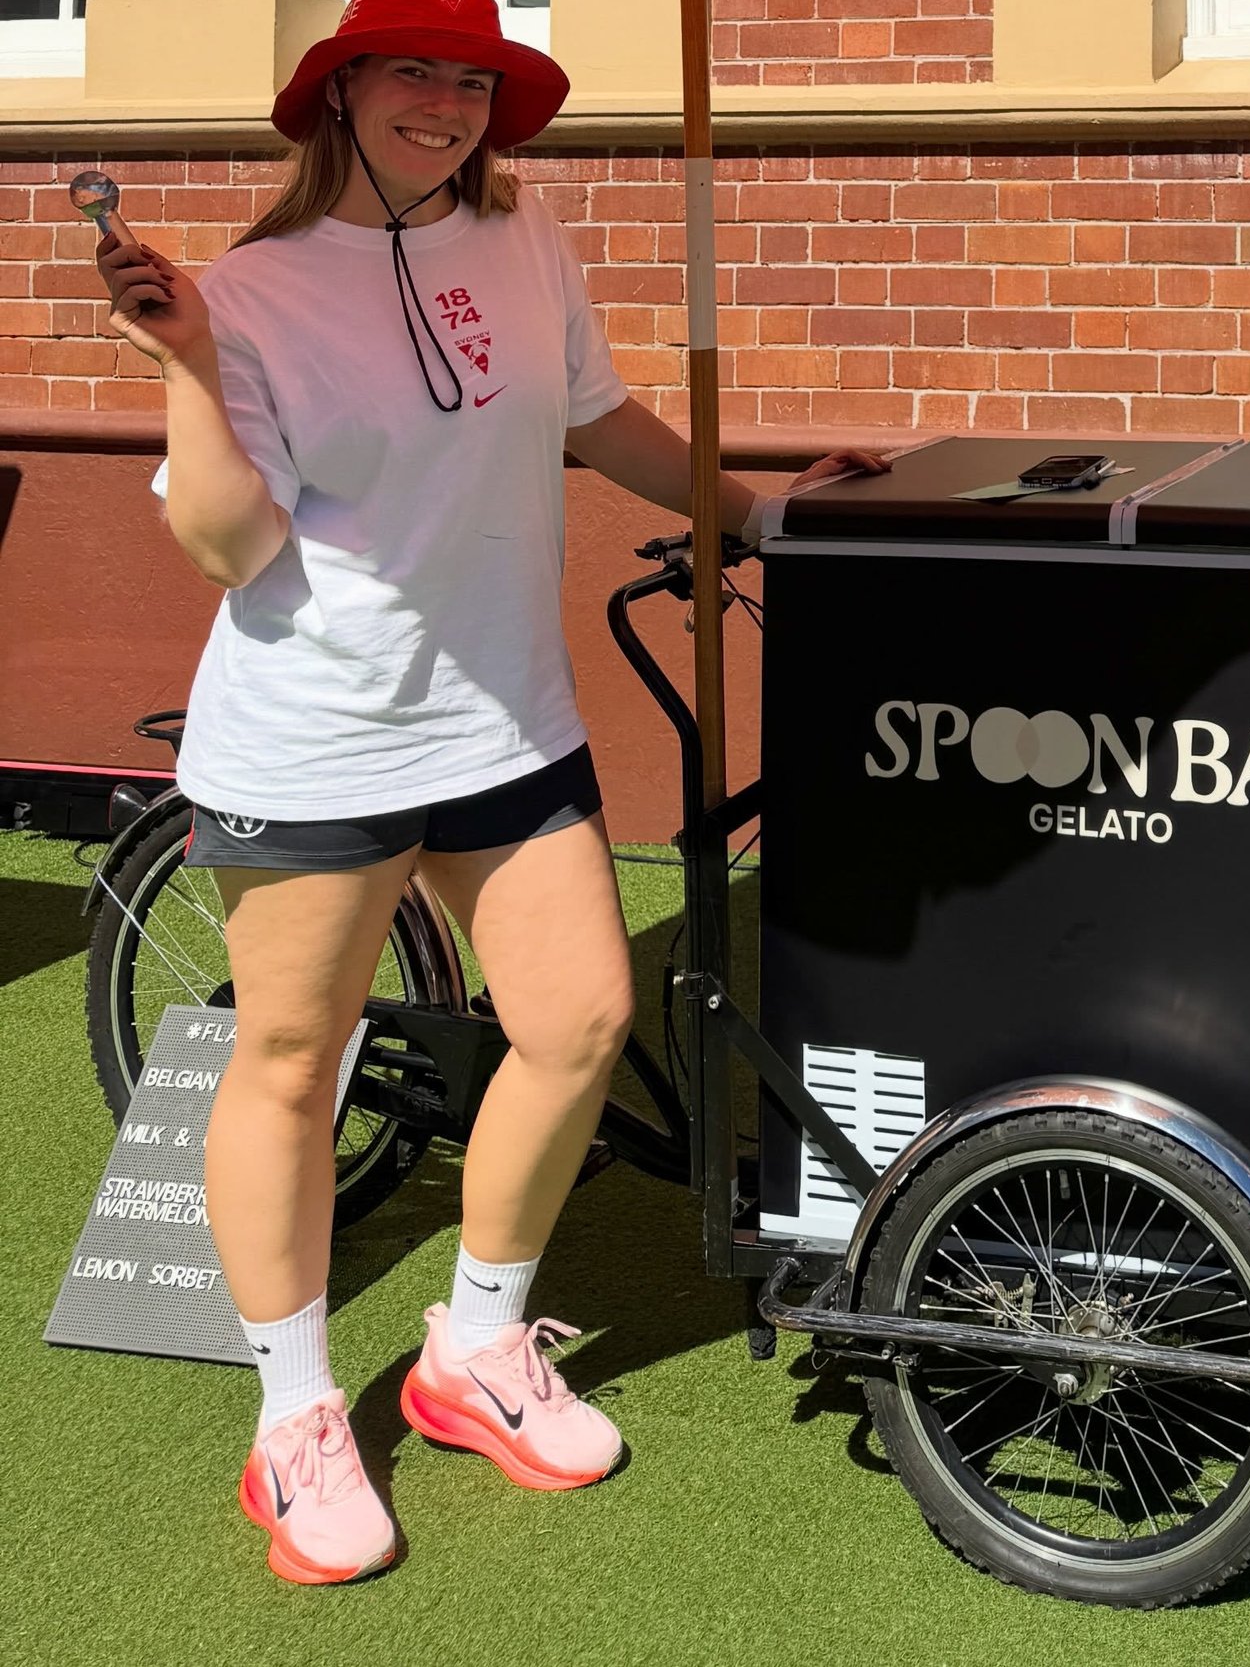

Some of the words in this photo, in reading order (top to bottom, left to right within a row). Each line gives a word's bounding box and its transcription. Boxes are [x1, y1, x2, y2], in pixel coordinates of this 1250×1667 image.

[435, 288, 471, 310] 18
[440, 306, 482, 330] 74
[454, 330, 490, 346] SYDNEY
[865, 700, 1155, 798] SPOON
[1029, 803, 1173, 843] GELATO
[143, 1067, 220, 1091] BELGIAN
[122, 1123, 167, 1145] MILK
[174, 1127, 191, 1147] &
[95, 1197, 209, 1226] WATERMELON
[72, 1256, 139, 1282] LEMON
[148, 1263, 222, 1291] SORBET
